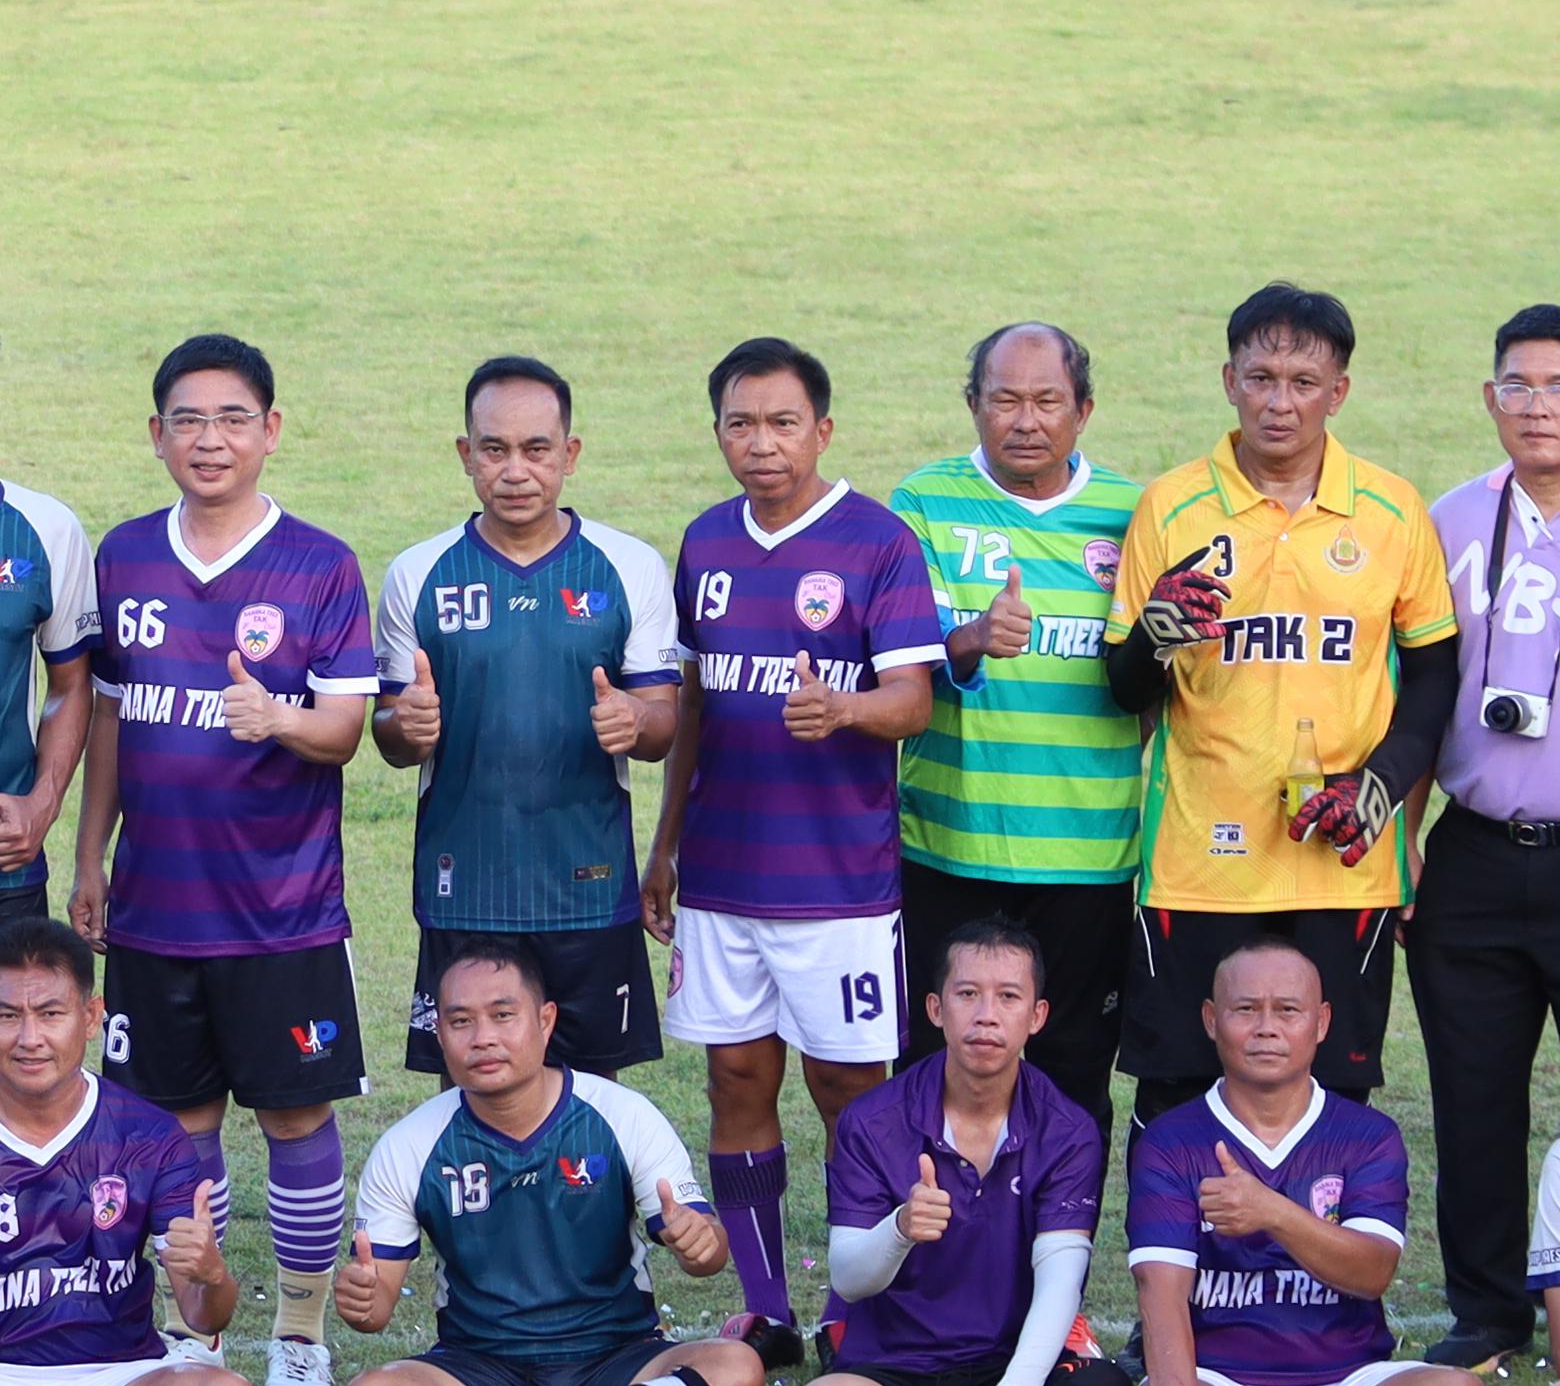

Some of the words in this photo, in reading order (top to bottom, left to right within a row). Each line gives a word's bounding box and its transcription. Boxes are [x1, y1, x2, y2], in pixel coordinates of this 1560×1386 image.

[951, 525, 1013, 582] 72
[1211, 533, 1235, 579] 3
[434, 581, 492, 635] 50
[694, 569, 733, 622] 19
[116, 597, 168, 649] 66
[1036, 614, 1107, 660] TREE
[1214, 613, 1308, 664] TAK
[1317, 616, 1356, 664] 2
[698, 653, 742, 694] NANA
[118, 682, 171, 726] NANA
[179, 689, 226, 731] TRE
[839, 970, 884, 1025] 19
[102, 1012, 132, 1066] 6
[1194, 1270, 1265, 1309] NANA
